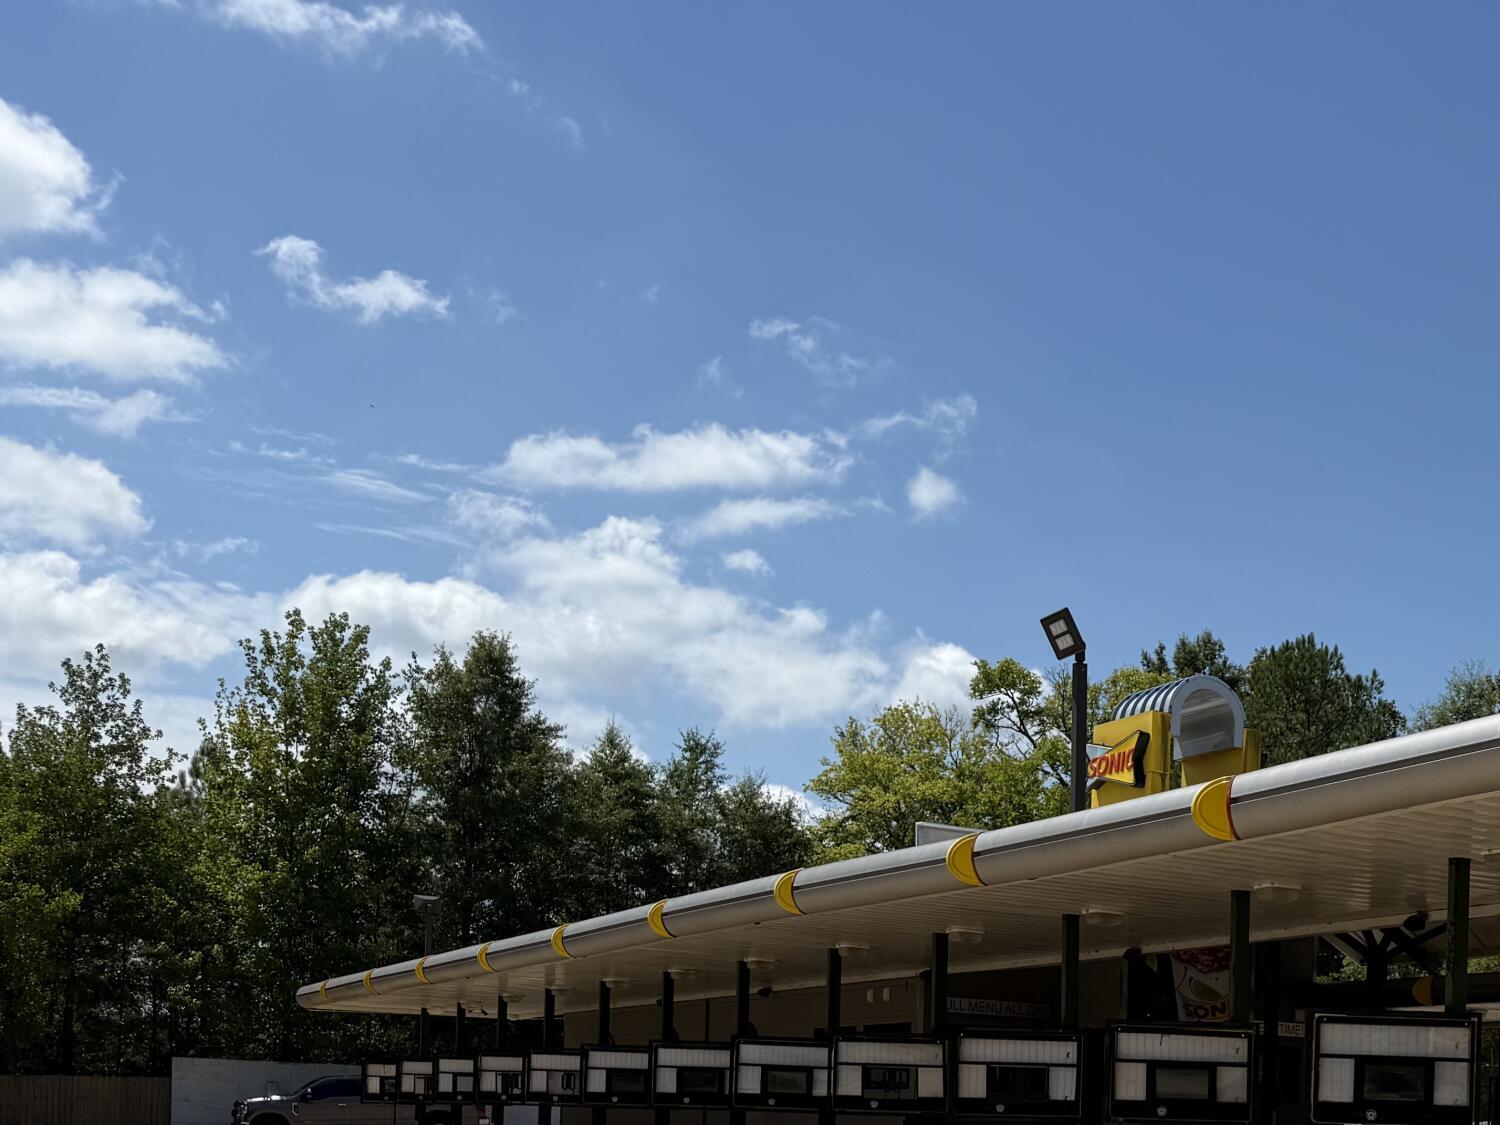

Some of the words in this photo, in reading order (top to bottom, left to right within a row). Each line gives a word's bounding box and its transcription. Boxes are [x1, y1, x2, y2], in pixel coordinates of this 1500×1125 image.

[1088, 748, 1135, 778] SONIC
[947, 999, 966, 1011] ULL
[968, 1000, 1002, 1014] MENU
[1184, 1000, 1229, 1018] SON
